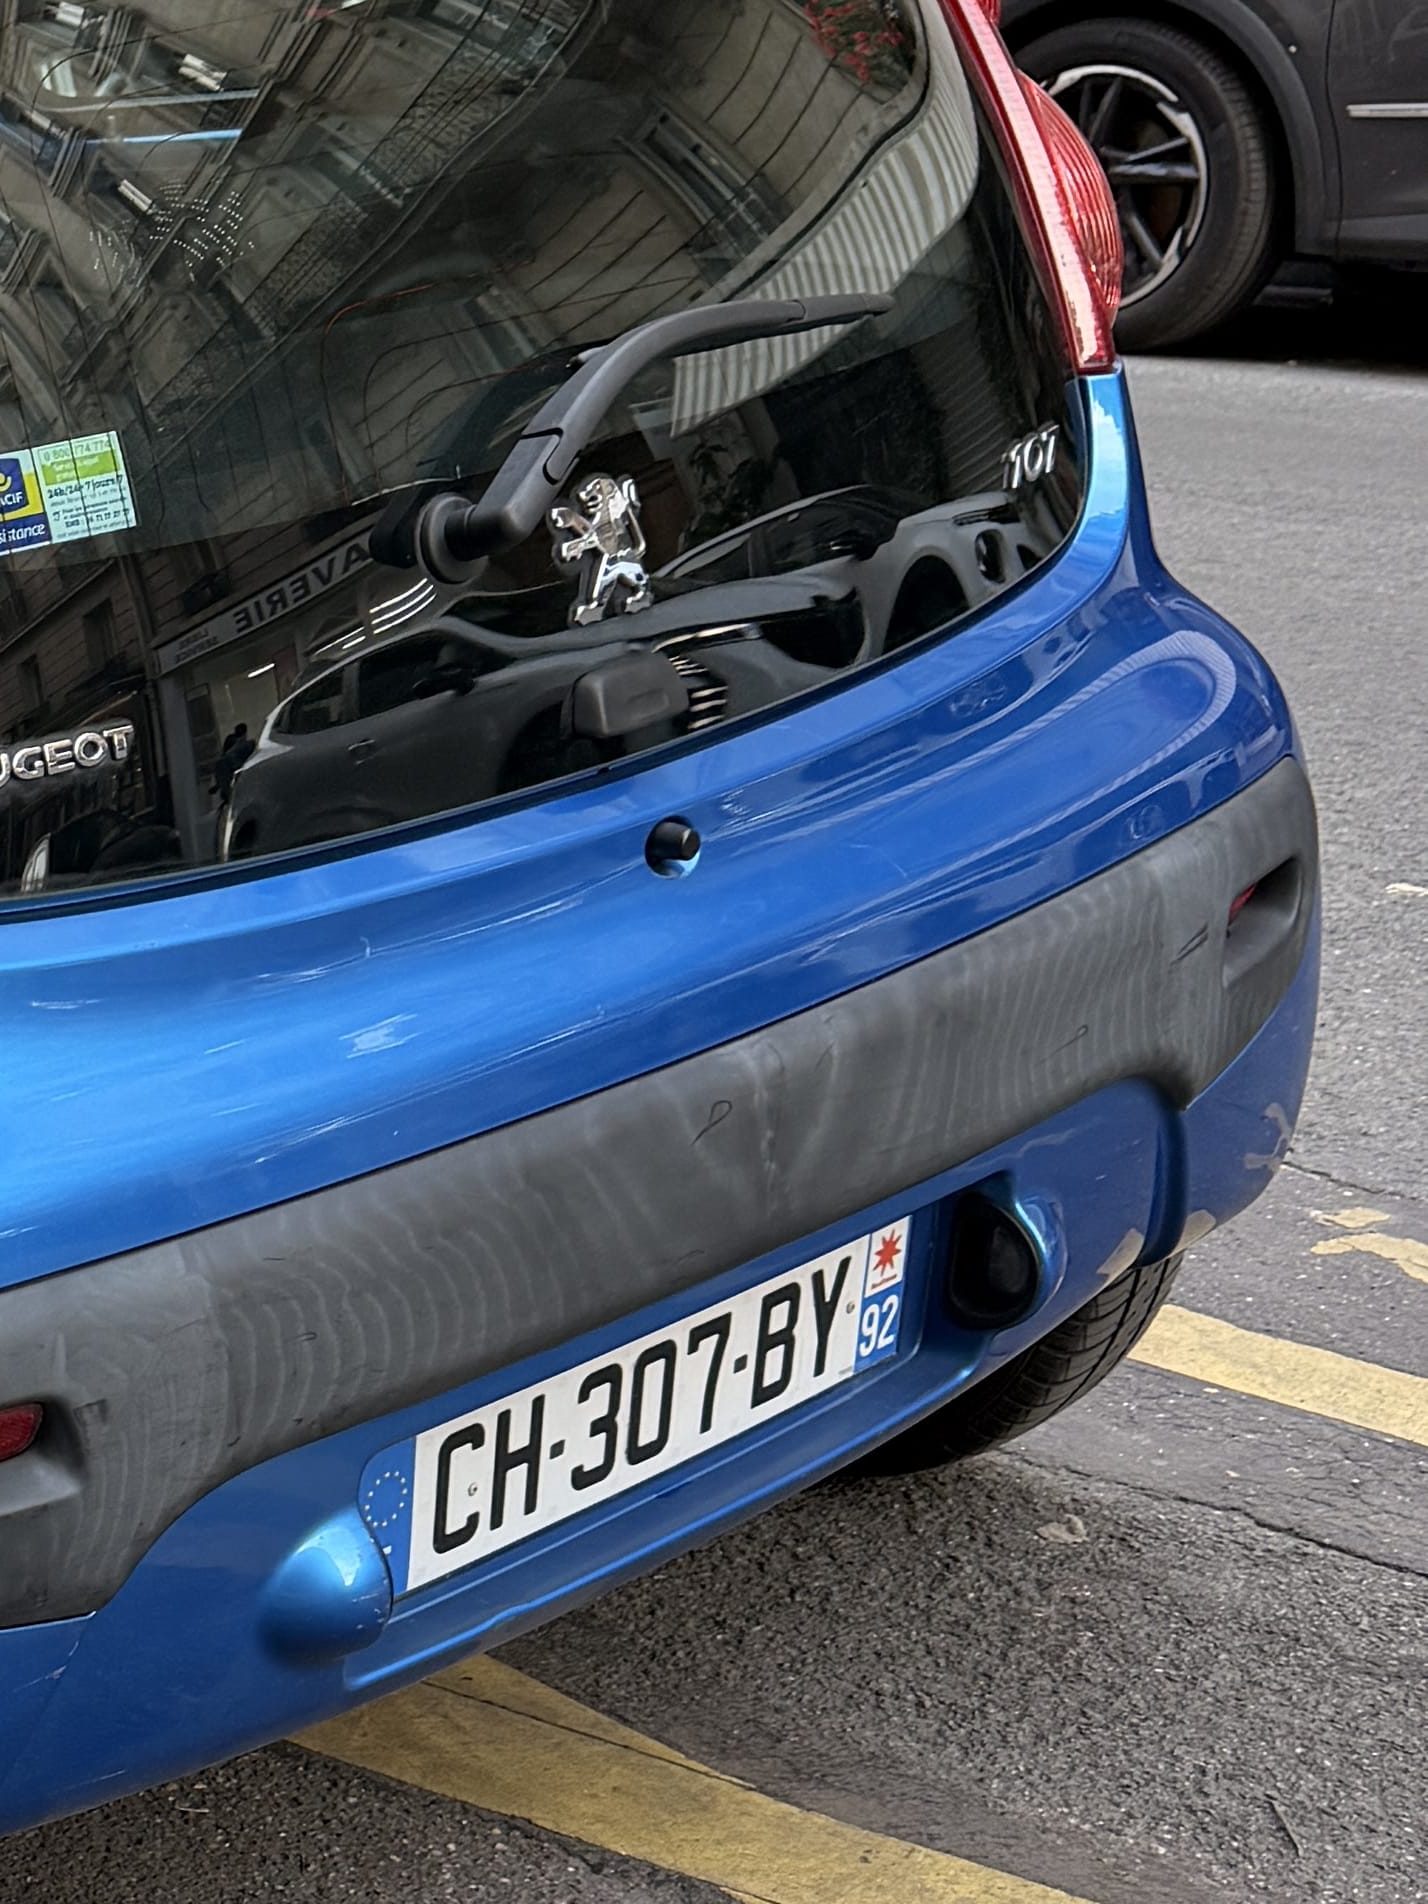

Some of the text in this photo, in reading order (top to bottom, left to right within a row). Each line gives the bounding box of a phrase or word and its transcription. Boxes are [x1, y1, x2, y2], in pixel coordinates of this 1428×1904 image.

[1008, 424, 1060, 489] 107
[859, 1294, 899, 1357] 92
[433, 1256, 852, 1554] CH-307-BY
